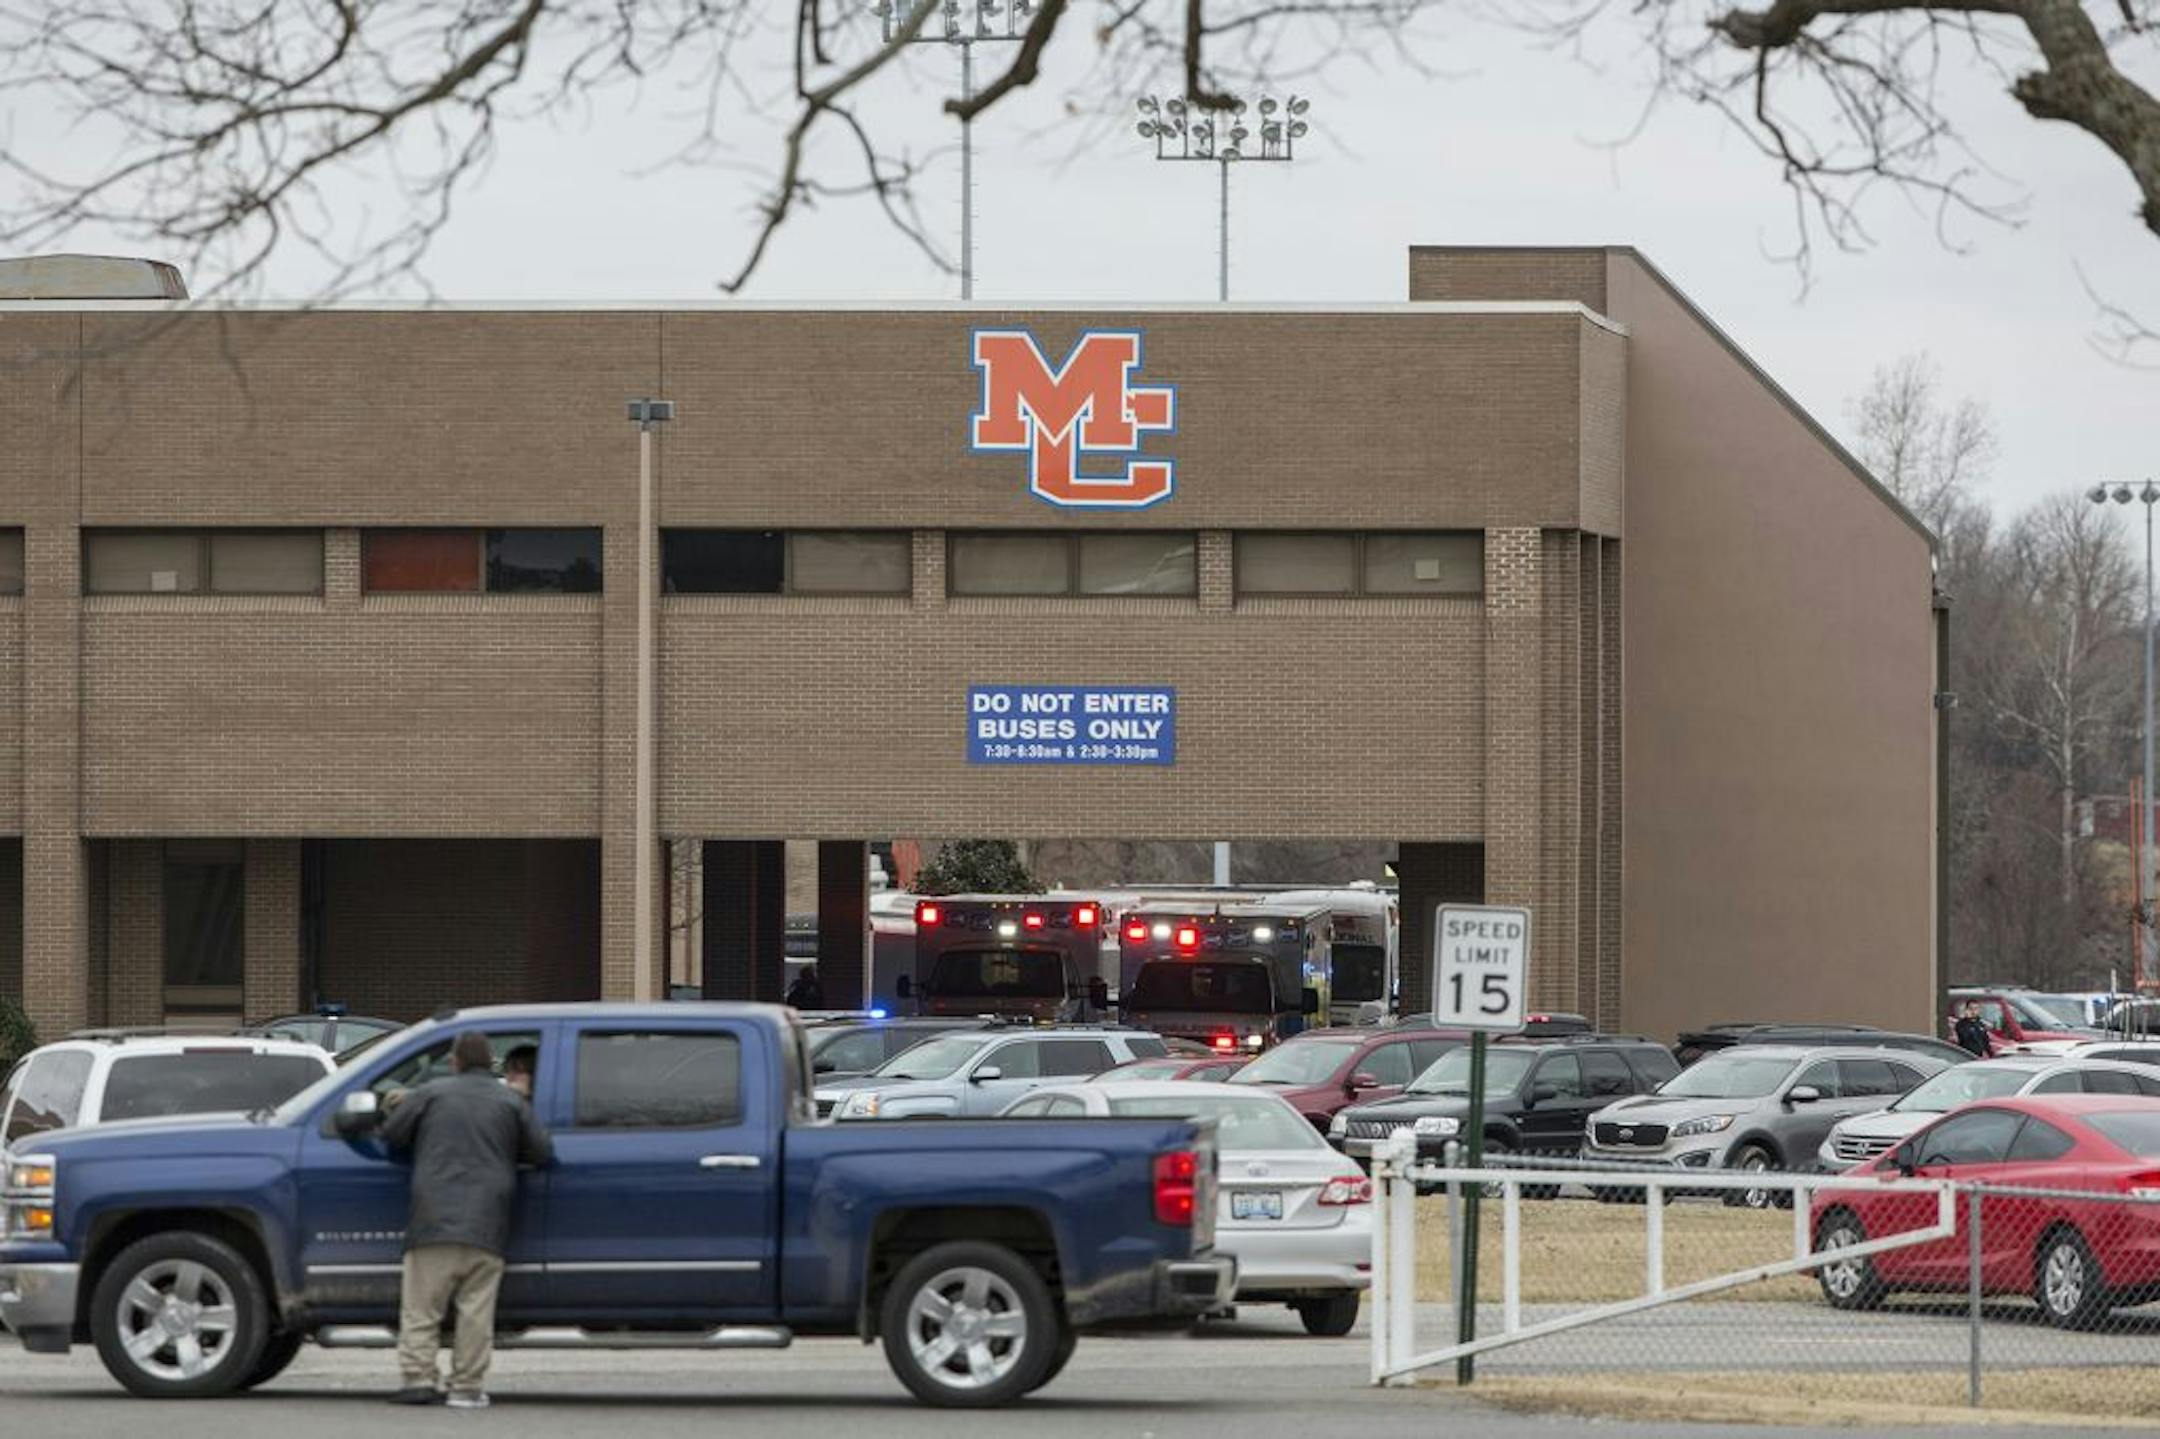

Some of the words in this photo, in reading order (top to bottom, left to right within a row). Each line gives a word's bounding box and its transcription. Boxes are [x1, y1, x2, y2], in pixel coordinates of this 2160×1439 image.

[972, 329, 1175, 508] MC
[973, 693, 1011, 713] DO
[1021, 693, 1075, 713] NOT
[1084, 694, 1170, 714] ENTER
[978, 719, 1077, 740] BUSES
[1088, 719, 1163, 740] ONLY
[1447, 920, 1521, 940] SPEED
[1455, 946, 1510, 964] LIMIT
[1450, 972, 1511, 1015] 15
